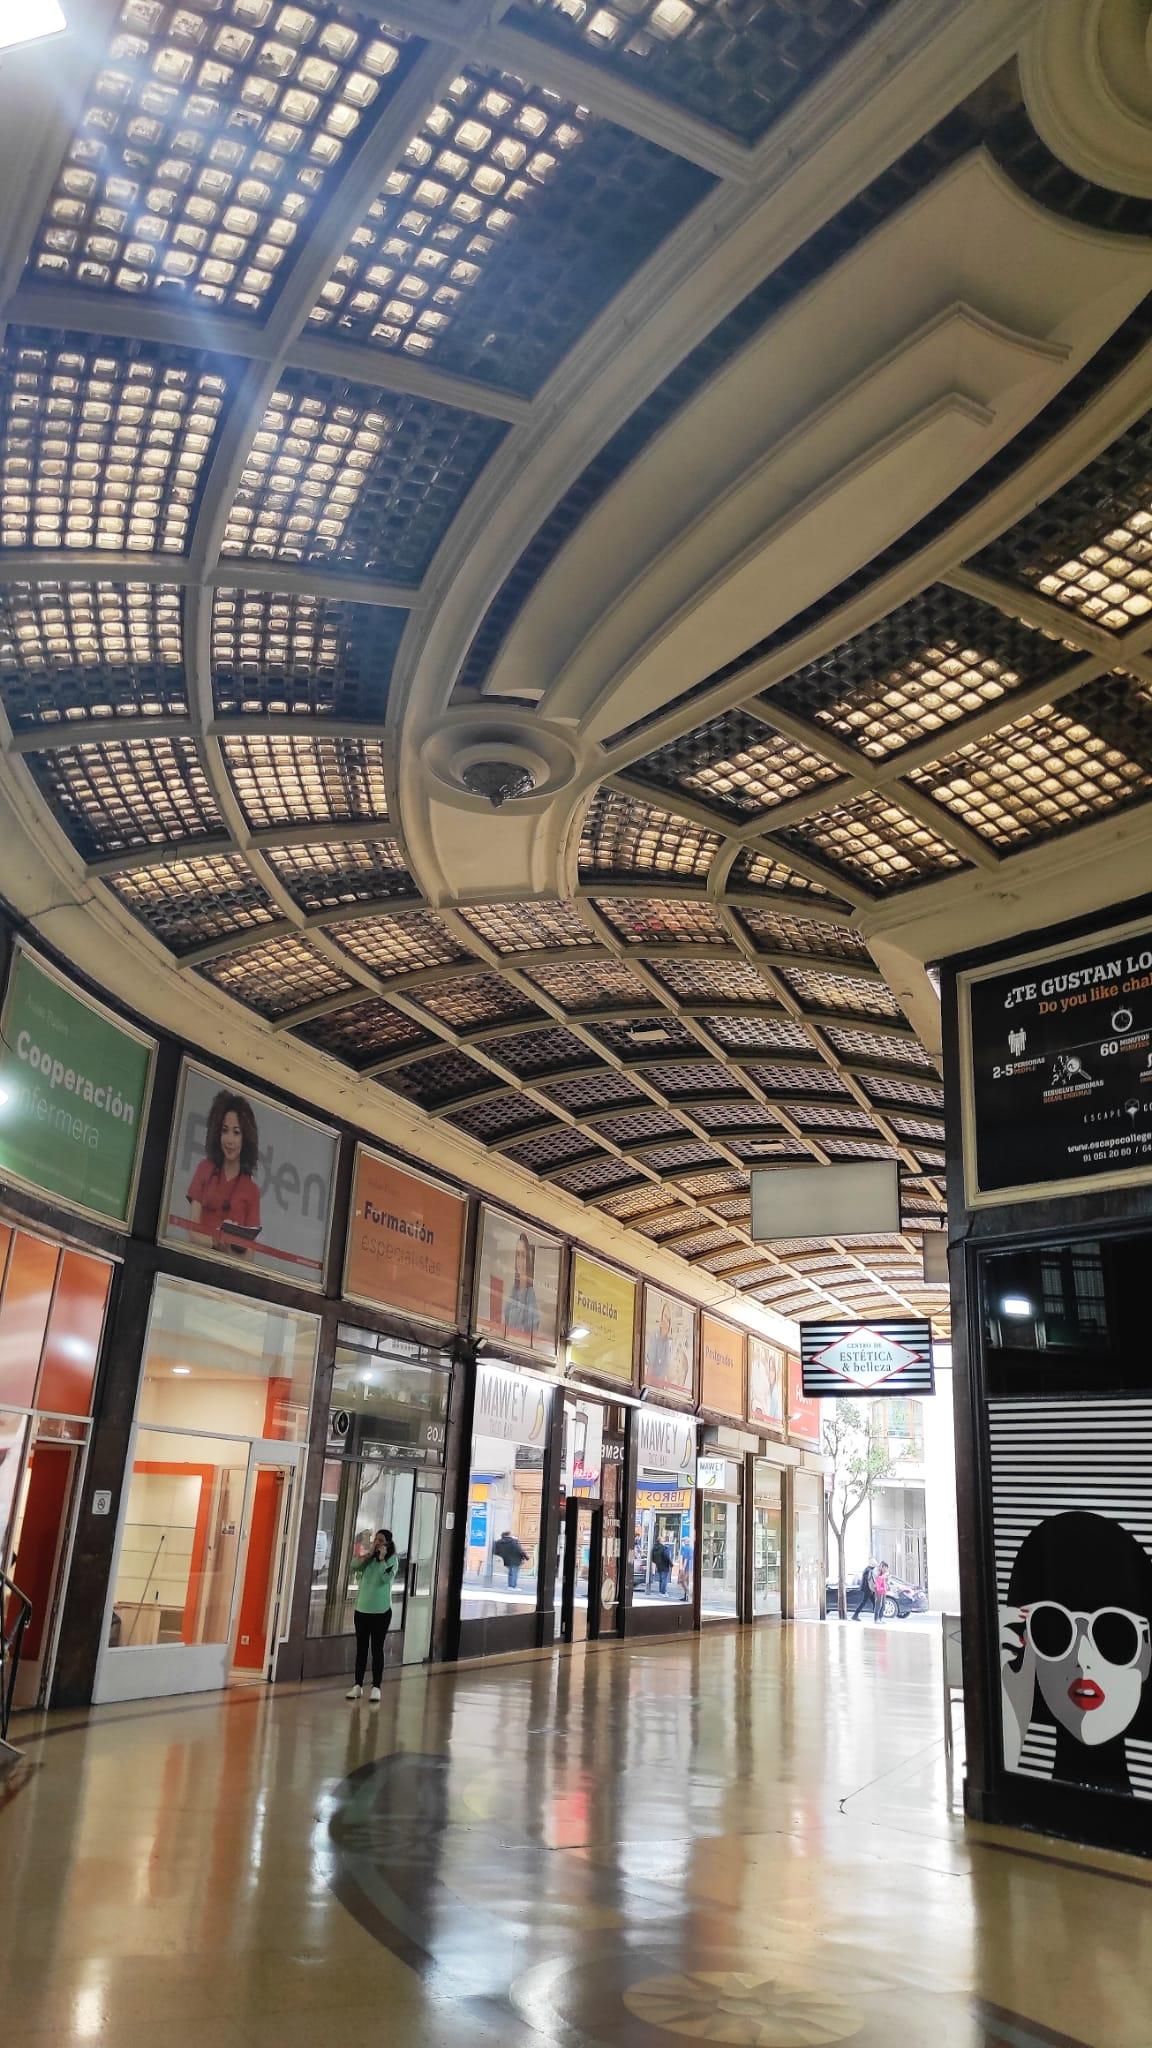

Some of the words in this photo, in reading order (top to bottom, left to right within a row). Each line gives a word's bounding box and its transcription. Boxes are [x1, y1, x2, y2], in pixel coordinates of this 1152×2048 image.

[1004, 984, 1037, 1008] ¿TE
[1041, 960, 1122, 996] GUSTAN
[1039, 1001, 1057, 1015] Do
[1061, 996, 1087, 1013] you
[1091, 985, 1119, 1001] like
[1100, 1041, 1118, 1056] 60
[17, 1030, 135, 1126] Cooperación
[992, 1064, 1014, 1079] 2-5
[1083, 1108, 1121, 1123] ESCAPE
[364, 1200, 434, 1246] Formación
[577, 1290, 618, 1321] Formación
[840, 1348, 893, 1362] ESTÉTICA
[842, 1362, 850, 1373] &
[853, 1361, 893, 1373] belleza
[479, 1373, 528, 1424] MAWEY
[640, 1417, 678, 1455] MAWEY
[699, 1462, 724, 1472] MAWEY
